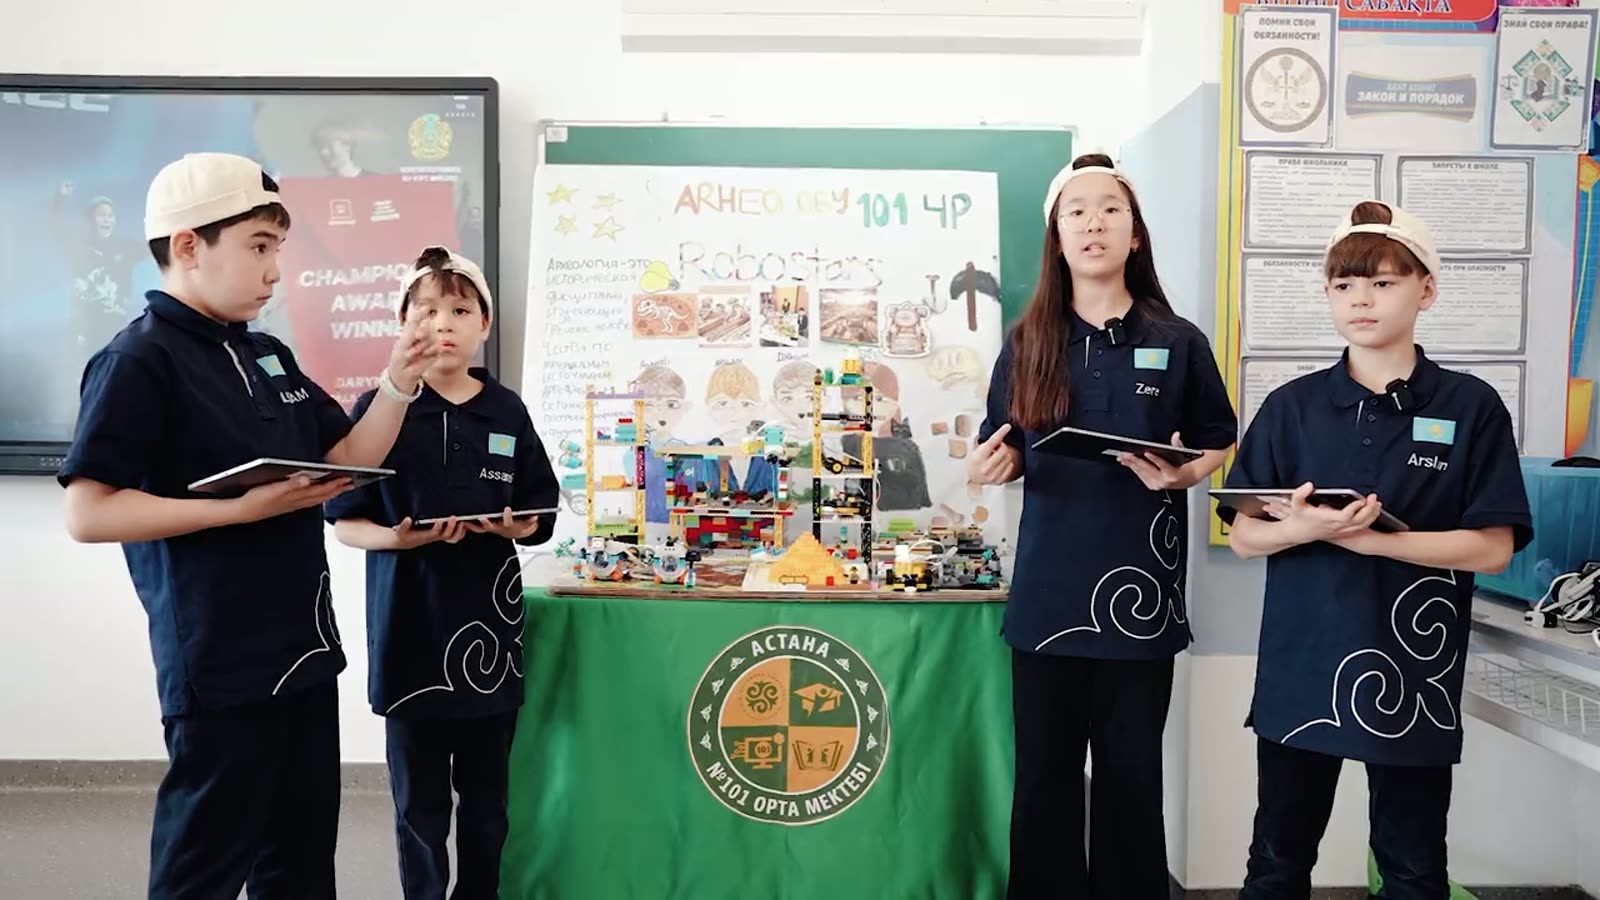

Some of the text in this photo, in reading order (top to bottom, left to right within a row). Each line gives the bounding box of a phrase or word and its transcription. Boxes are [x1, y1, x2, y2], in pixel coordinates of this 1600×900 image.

[1357, 91, 1464, 105] ЗАКОН И ПОРЯДОК
[856, 192, 909, 228] 101
[751, 633, 830, 659] АСТАНА
[706, 761, 873, 817] №101 ОРТА МЕКТЕБІ
